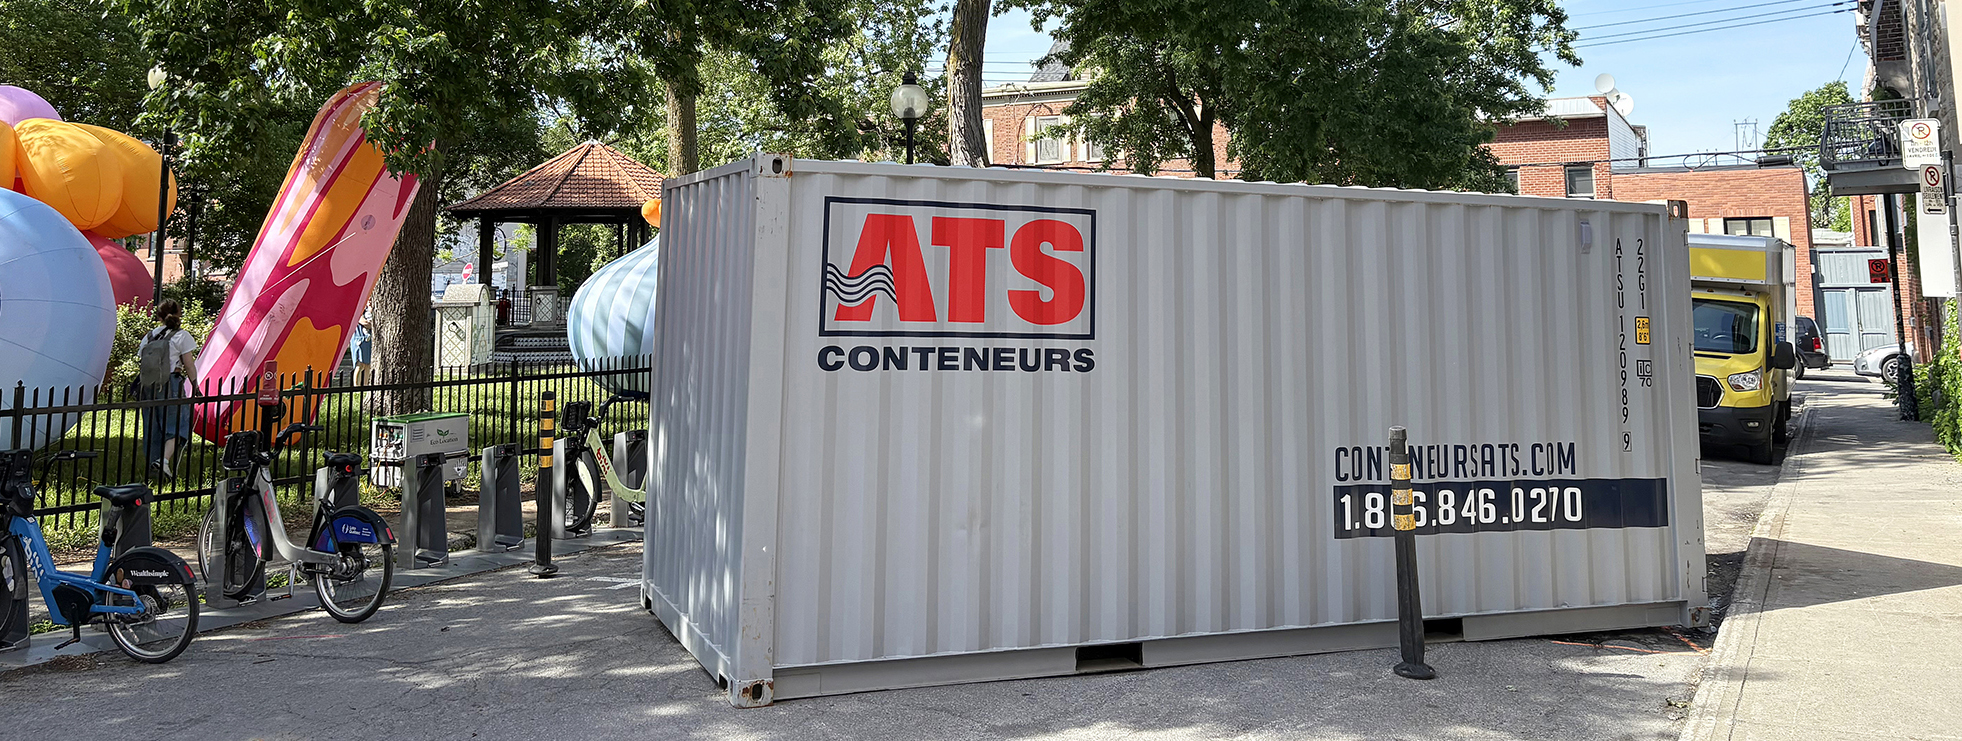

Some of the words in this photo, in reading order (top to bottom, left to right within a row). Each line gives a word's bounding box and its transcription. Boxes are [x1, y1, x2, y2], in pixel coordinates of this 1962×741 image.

[834, 213, 1085, 325] ATS
[1616, 237, 1624, 309] ATSU
[1636, 238, 1645, 309] 22G1
[817, 345, 1095, 372] CONTENEURS
[1619, 315, 1628, 424] 120989
[1639, 377, 1652, 387] 70
[1335, 442, 1576, 481] CONNEURSATS.COM
[1340, 486, 1583, 531] 1.86.846.0270
[130, 570, 169, 578] Wealthsimple
